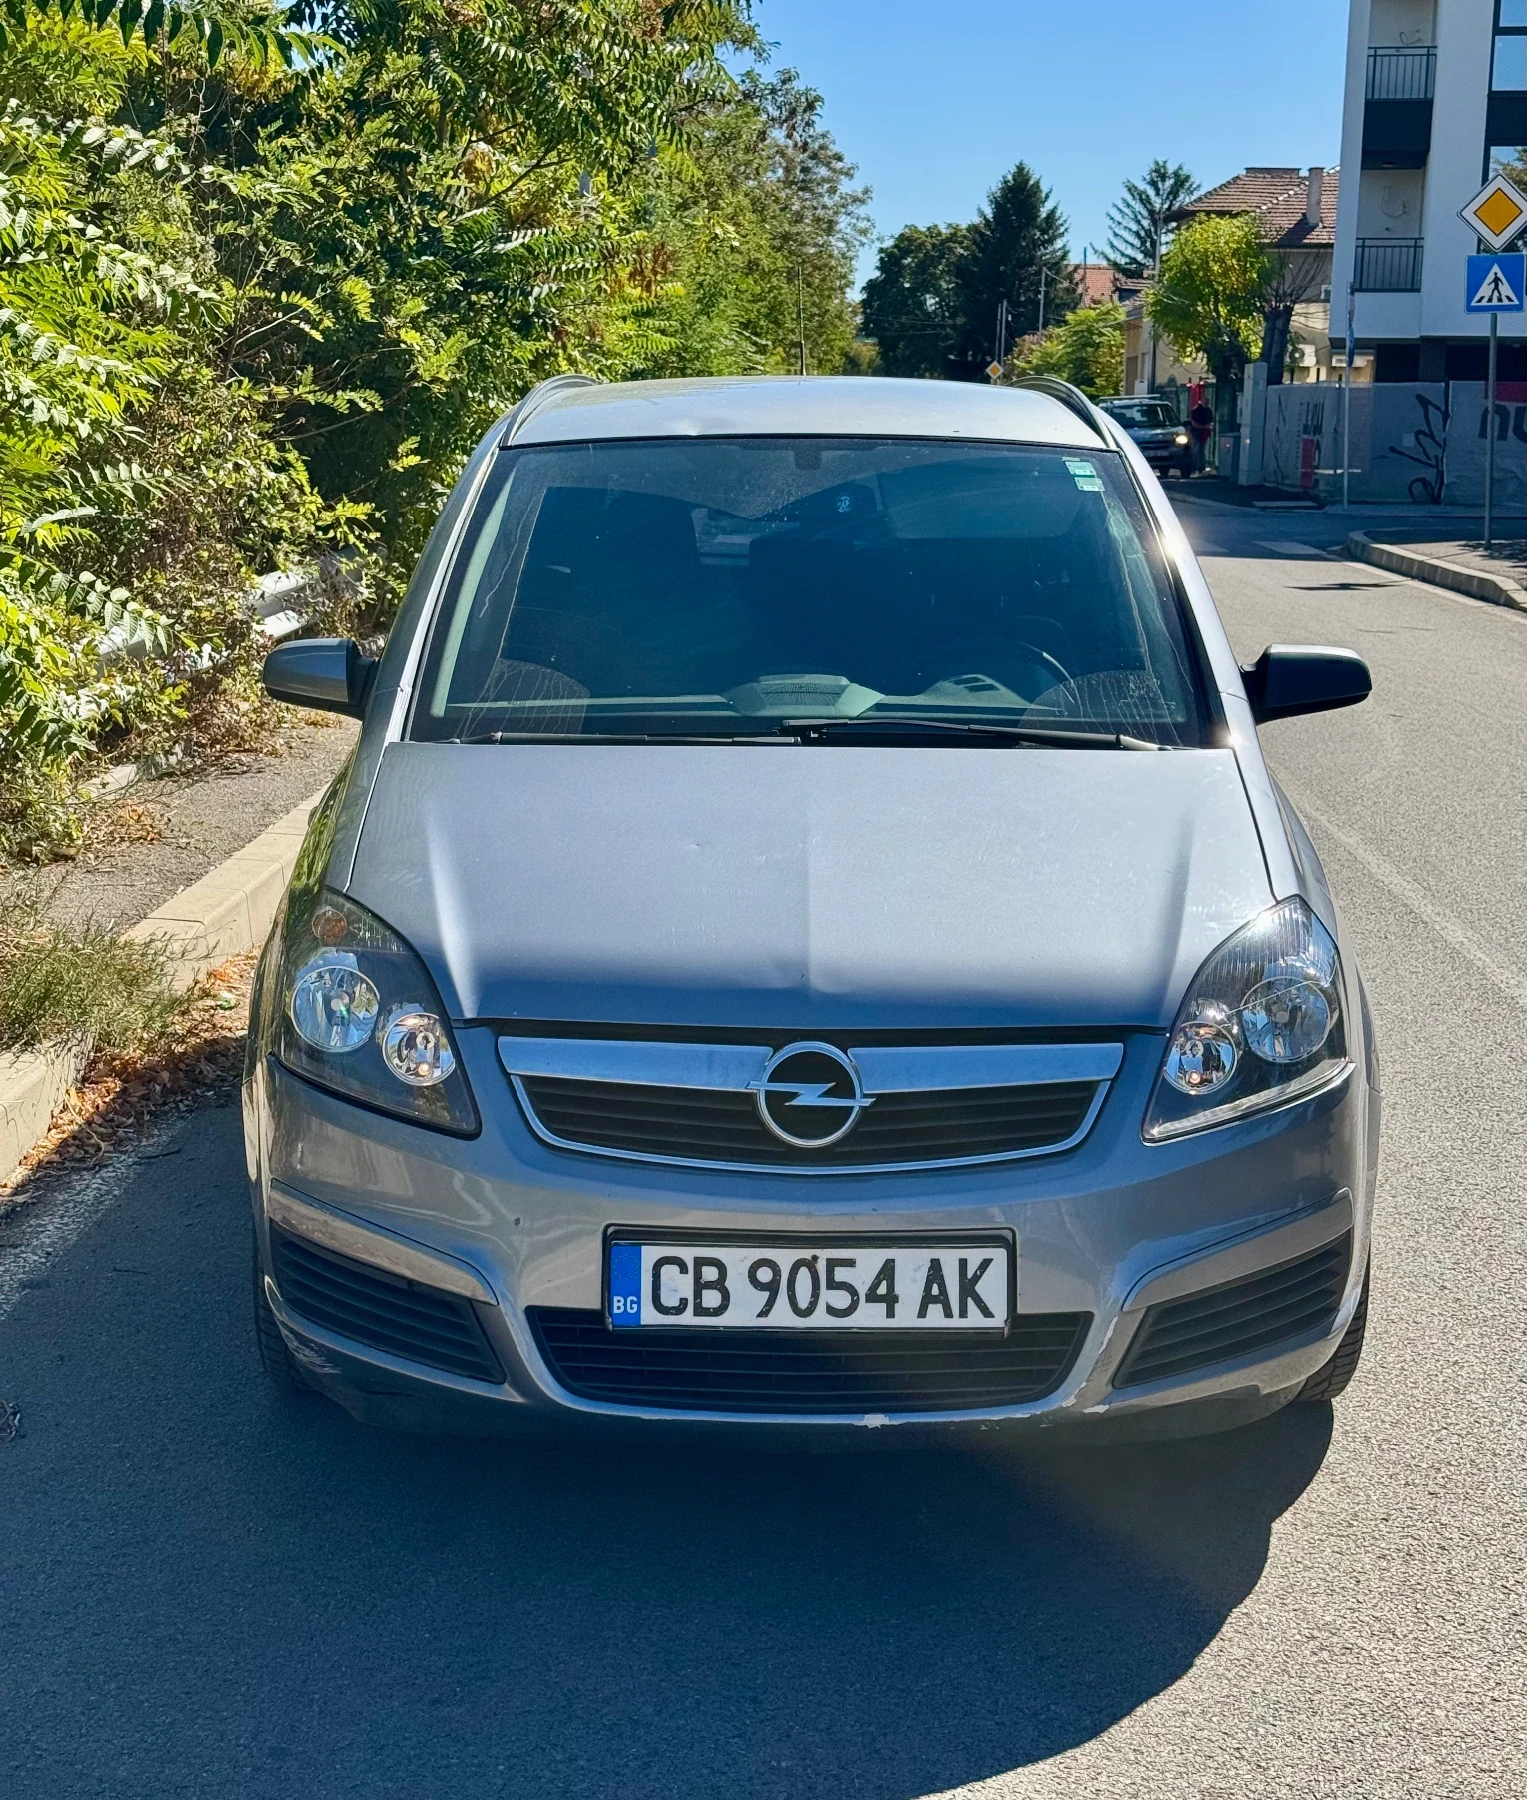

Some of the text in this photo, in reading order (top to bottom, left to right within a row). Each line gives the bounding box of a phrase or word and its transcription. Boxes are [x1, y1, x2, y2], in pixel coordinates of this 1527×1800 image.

[613, 1295, 638, 1314] BG
[651, 1255, 996, 1319] CB 9054 AK
